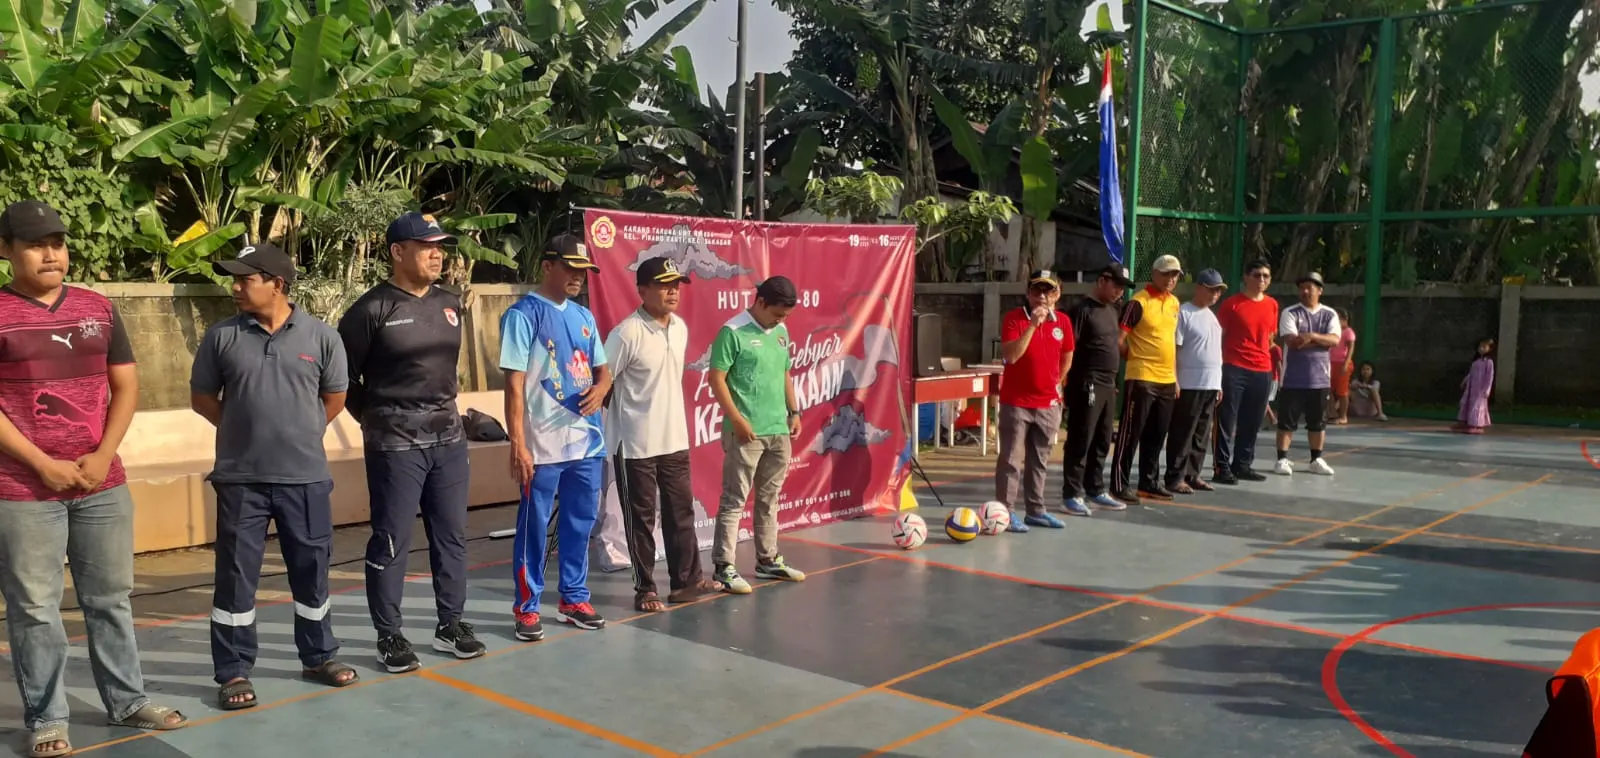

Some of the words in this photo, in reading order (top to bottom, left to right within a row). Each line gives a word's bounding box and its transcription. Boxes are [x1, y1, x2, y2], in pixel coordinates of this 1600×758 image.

[624, 225, 650, 234] KARANG
[849, 234, 860, 247] 19
[879, 234, 889, 247] 16
[717, 290, 752, 309] HUT
